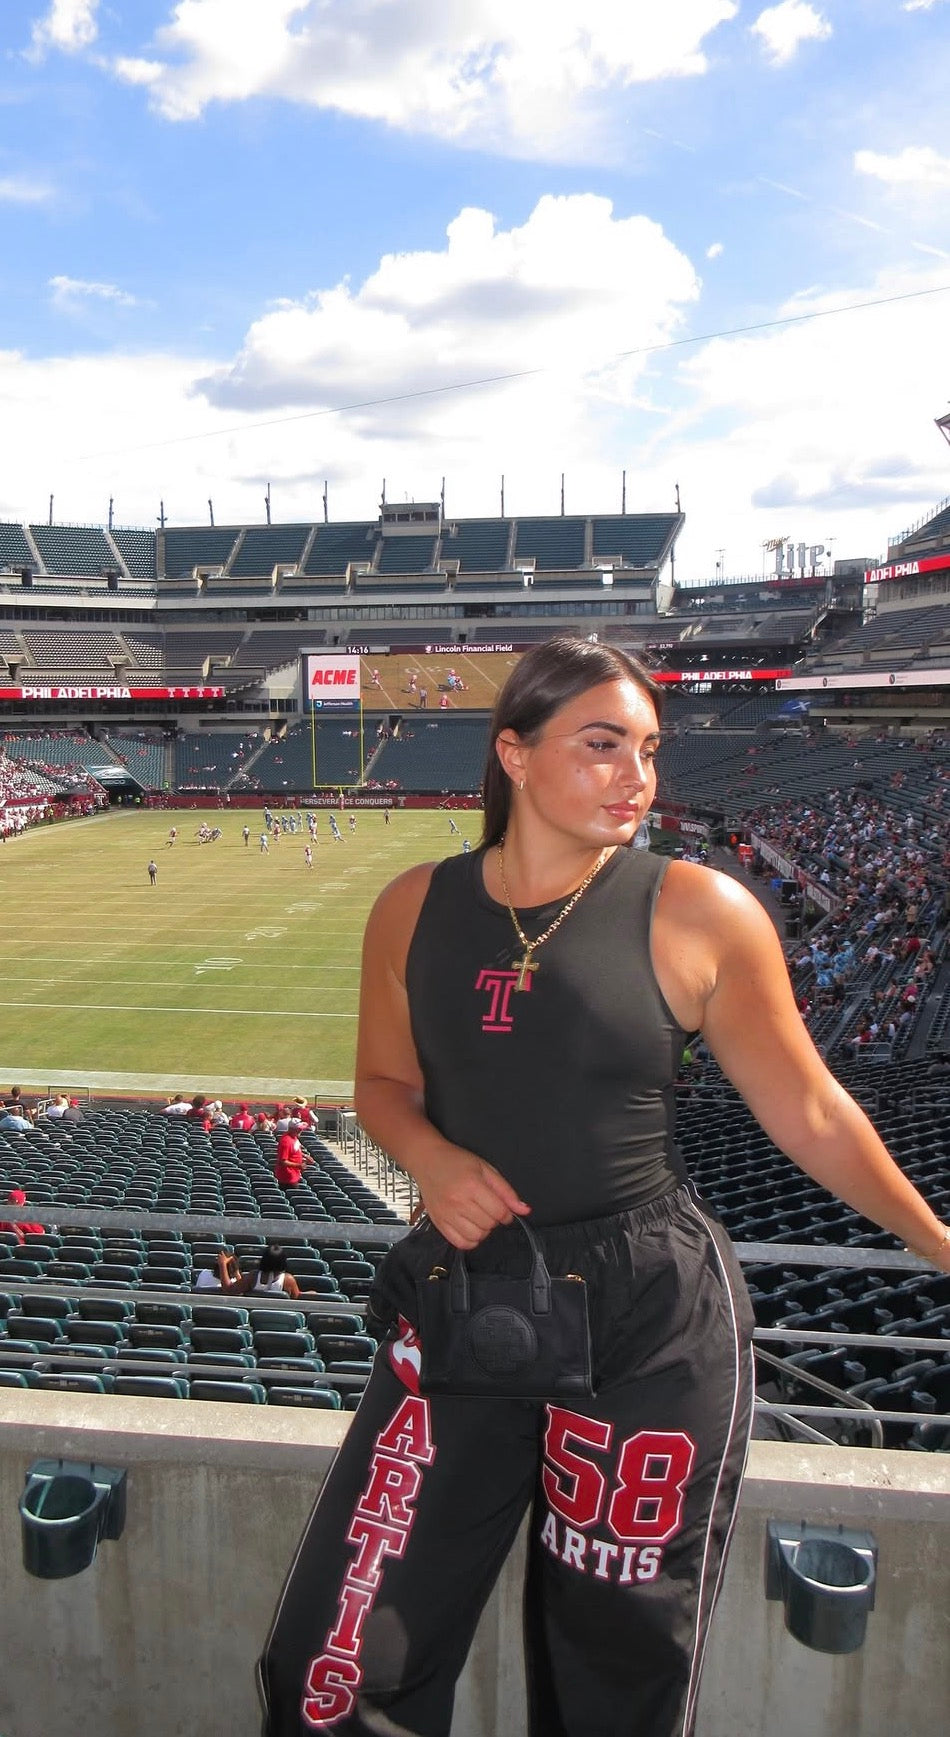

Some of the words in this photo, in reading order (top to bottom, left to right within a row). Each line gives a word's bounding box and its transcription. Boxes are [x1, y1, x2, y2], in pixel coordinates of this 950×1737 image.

[771, 543, 824, 577] Lite
[347, 646, 369, 654] 14:16
[435, 645, 461, 653] Lincoln
[462, 645, 495, 653] Financial
[495, 644, 513, 652] Field
[312, 669, 357, 685] ACME
[681, 671, 752, 681] PHILADELPHIA
[22, 687, 132, 699] PHILADELPHIA
[475, 969, 532, 1032] T
[541, 1402, 697, 1542] 58
[540, 1511, 663, 1582] ARTIS
[301, 1394, 437, 1727] ARTIS
